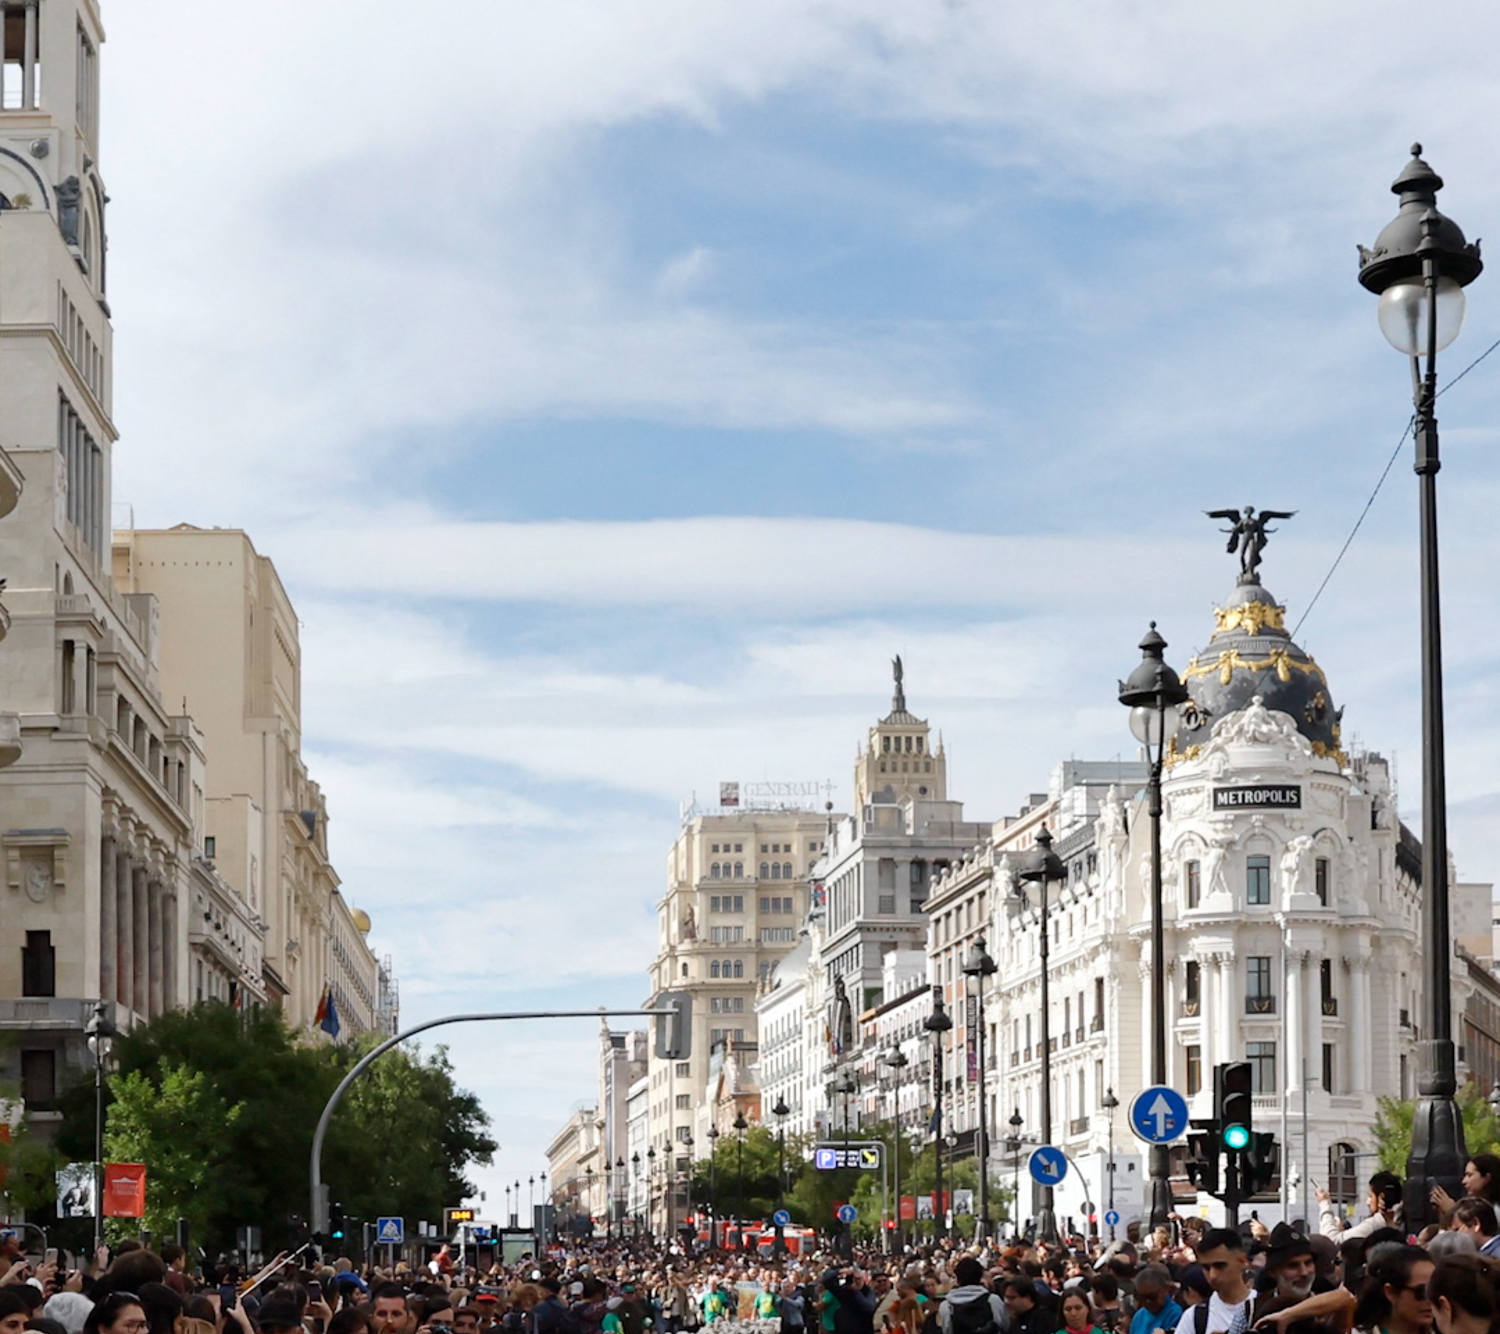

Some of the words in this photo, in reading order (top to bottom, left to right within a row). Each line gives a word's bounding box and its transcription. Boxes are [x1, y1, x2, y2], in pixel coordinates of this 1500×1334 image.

[744, 782, 819, 795] GENERALI
[1217, 790, 1298, 805] METROPOLIS
[821, 1152, 831, 1166] P
